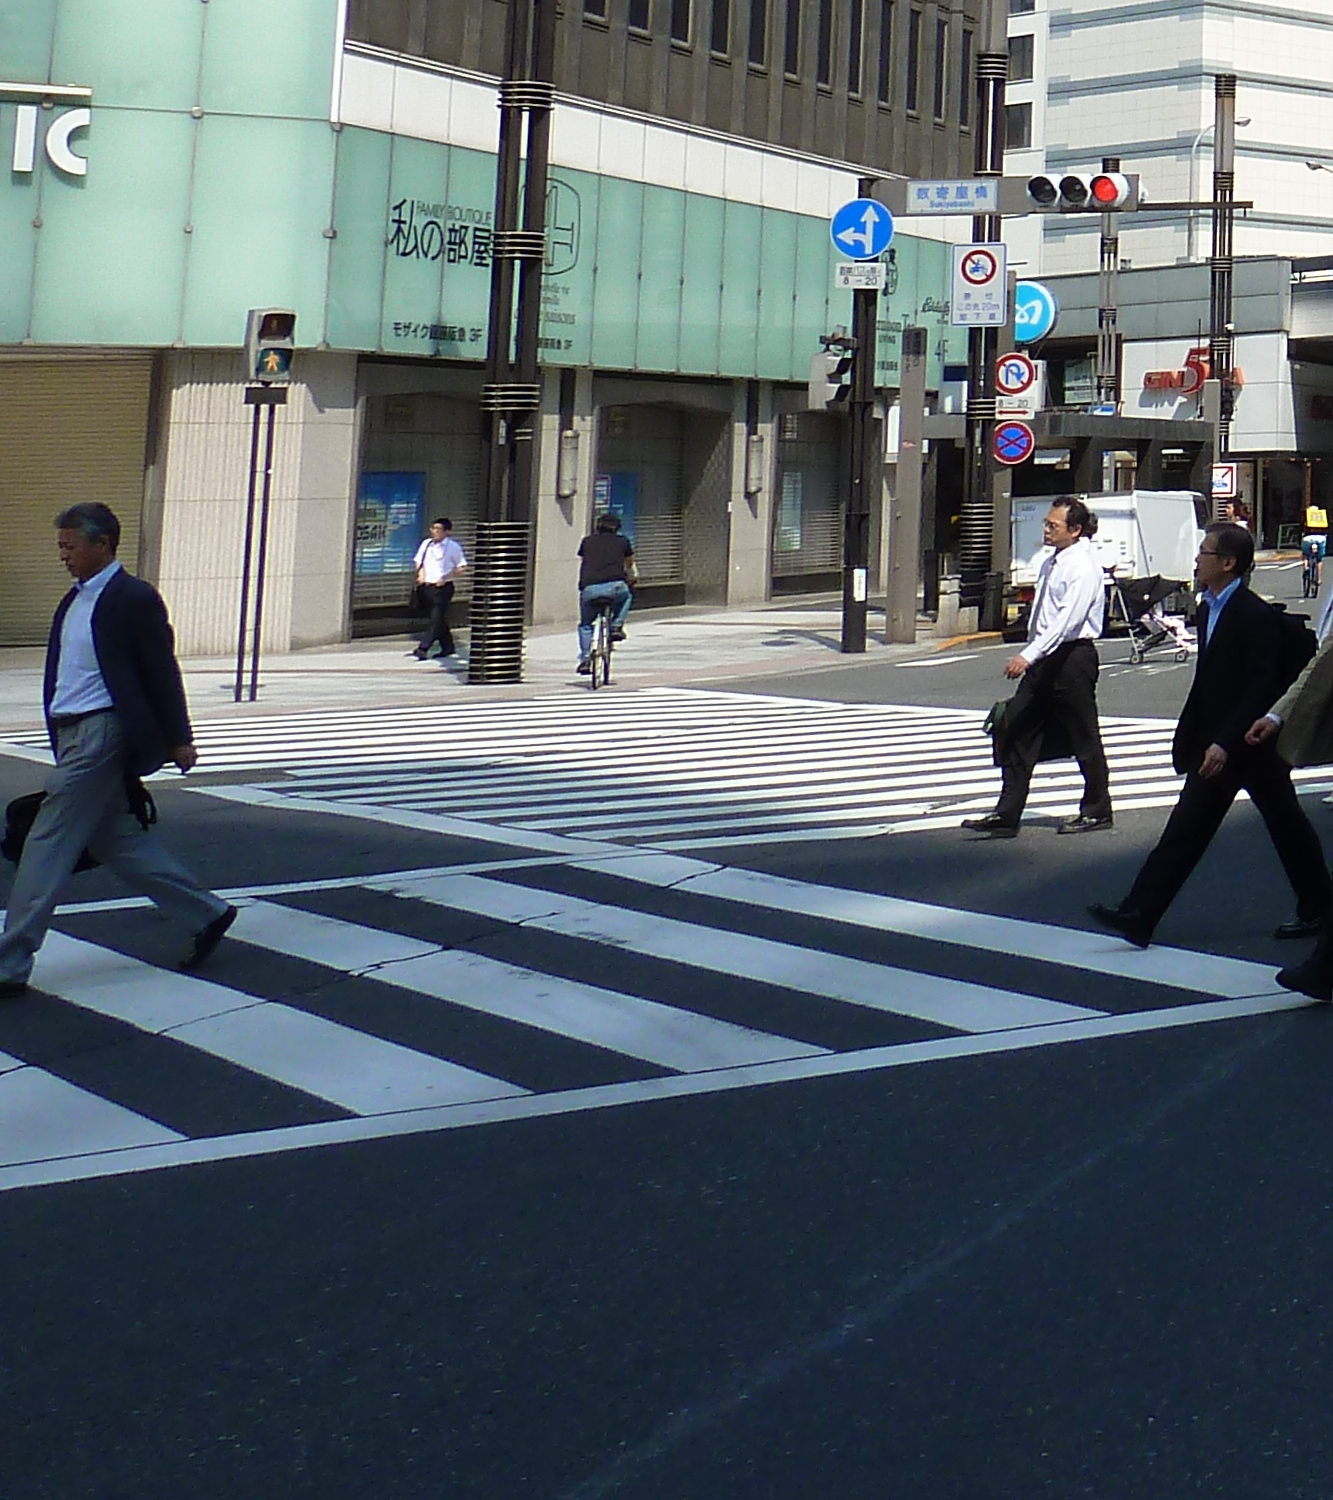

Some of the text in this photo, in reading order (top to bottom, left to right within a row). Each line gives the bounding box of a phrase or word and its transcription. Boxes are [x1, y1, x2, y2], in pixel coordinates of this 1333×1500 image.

[389, 198, 492, 268] 私の部屋
[416, 200, 493, 226] FAMILY BOUTIQUE
